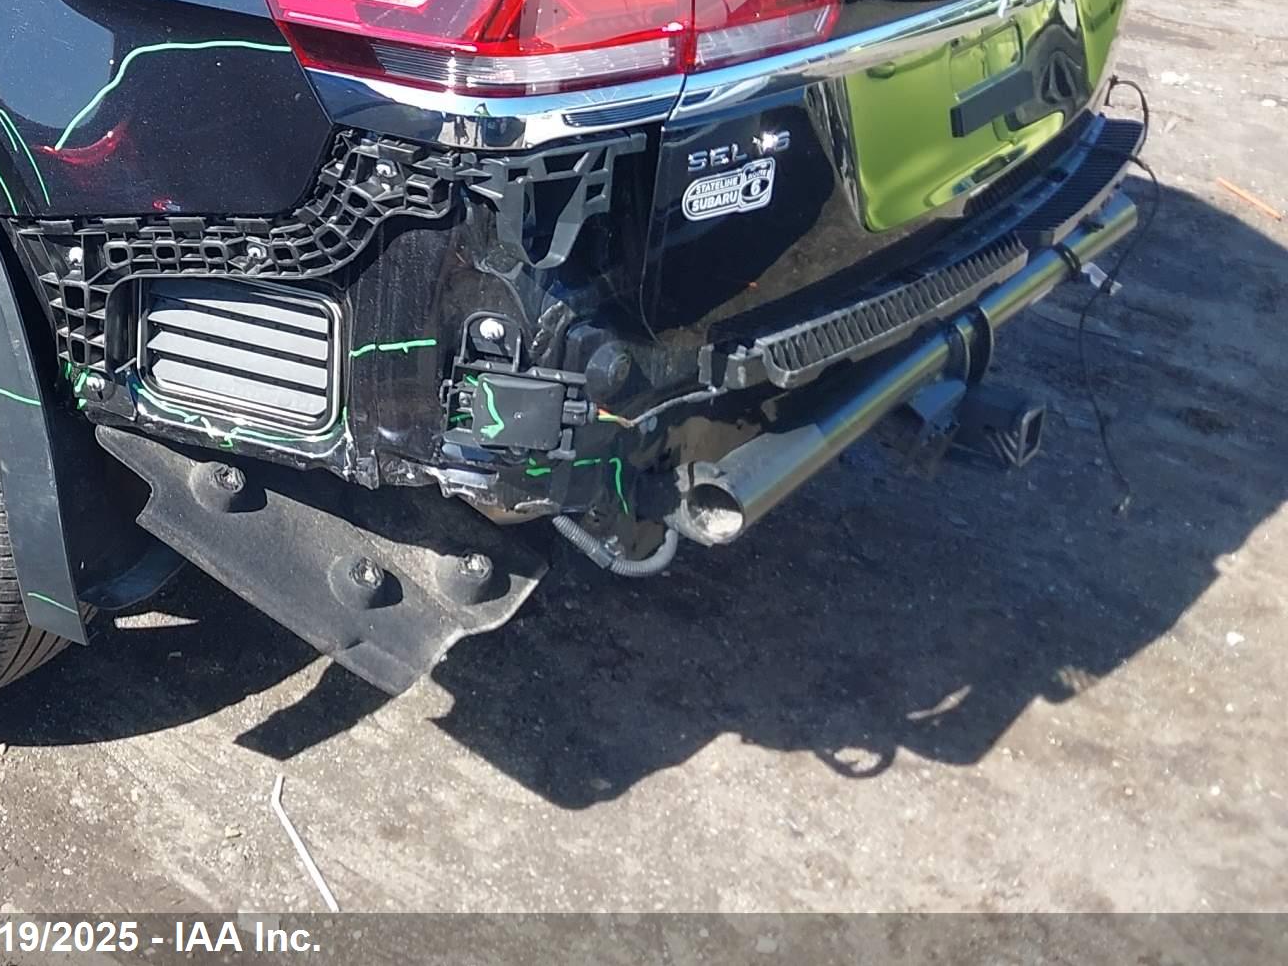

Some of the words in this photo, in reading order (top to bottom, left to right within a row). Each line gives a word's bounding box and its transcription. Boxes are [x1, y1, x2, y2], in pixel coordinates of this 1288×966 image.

[687, 143, 748, 173] SEL
[695, 176, 739, 195] STATELINE
[750, 178, 762, 196] 6
[692, 190, 738, 212] SUBARU
